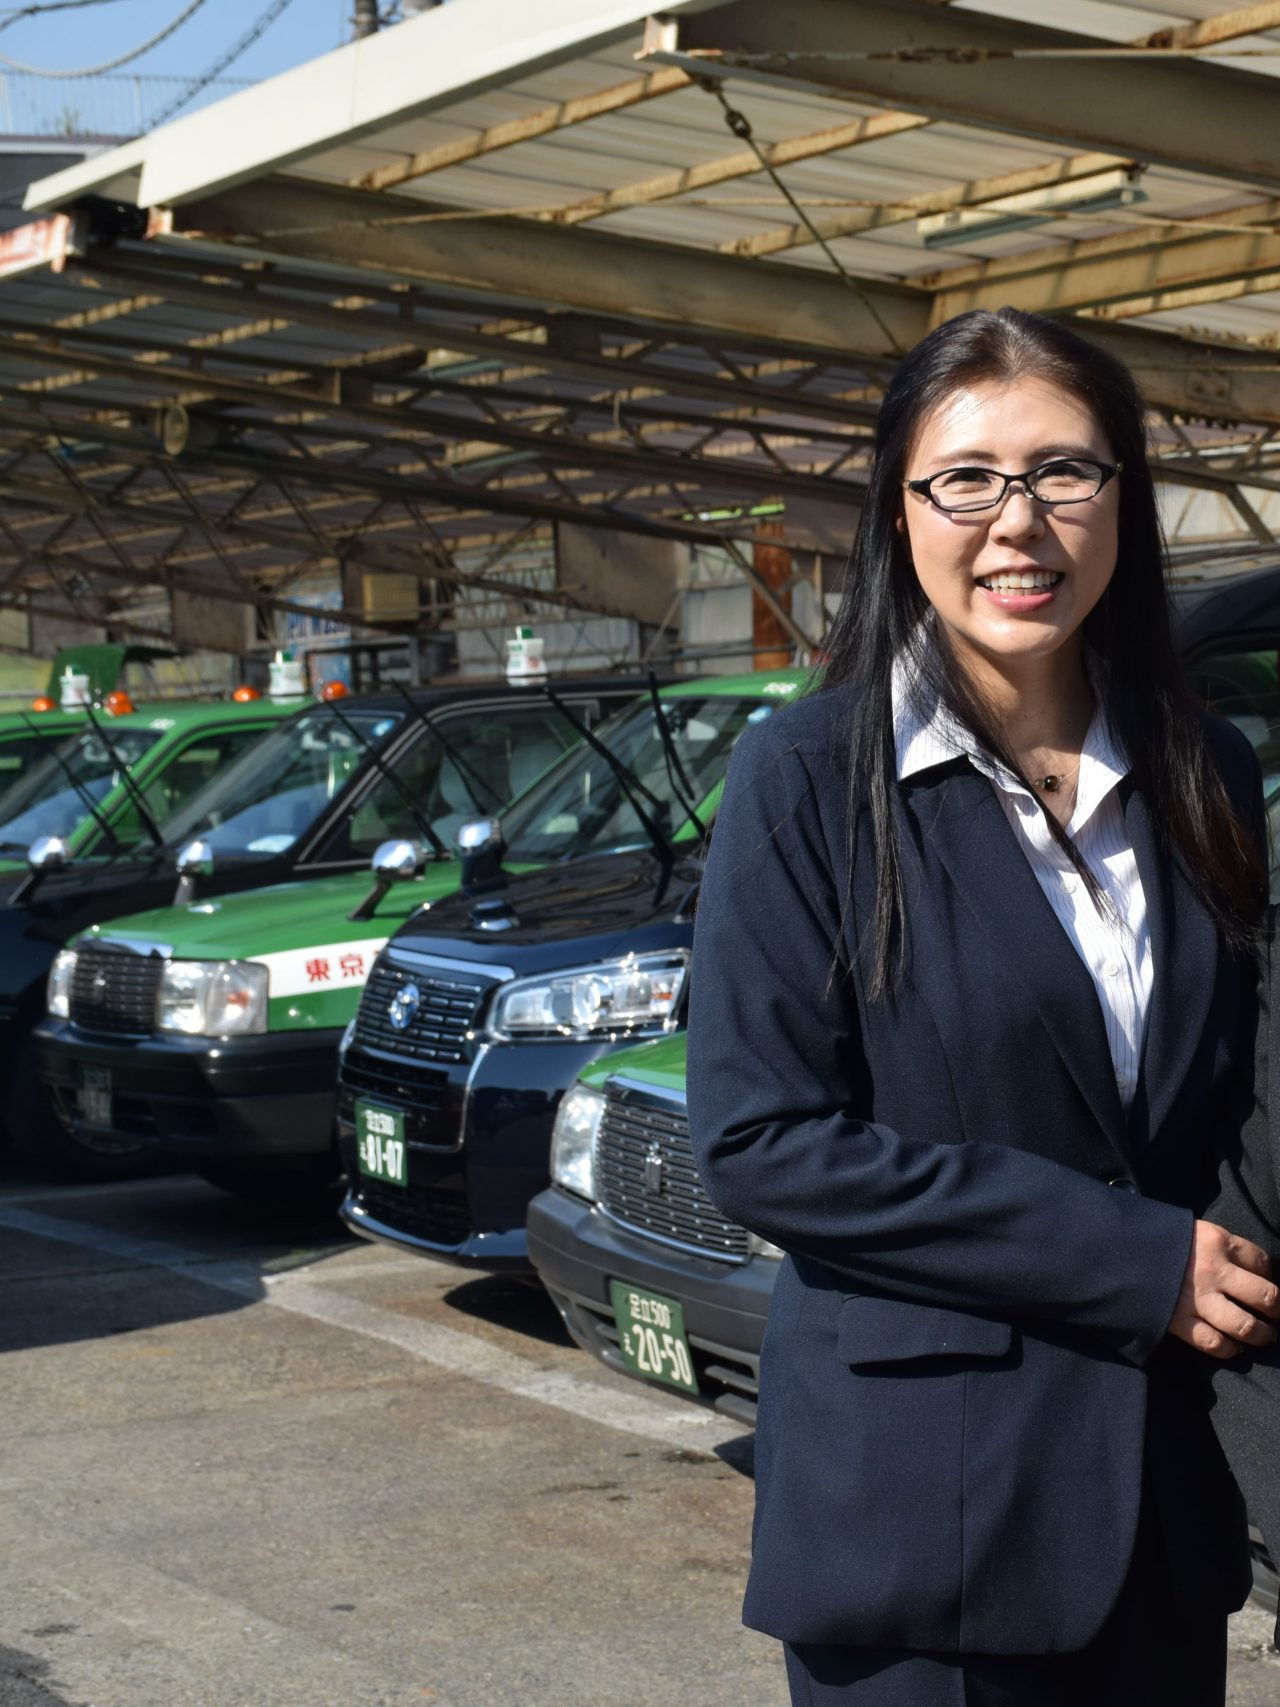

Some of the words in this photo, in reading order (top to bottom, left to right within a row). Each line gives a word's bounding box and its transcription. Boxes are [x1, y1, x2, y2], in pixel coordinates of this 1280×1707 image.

[304, 949, 381, 983] 東京
[366, 1133, 403, 1180] 81-07
[632, 1323, 693, 1386] 20-50
